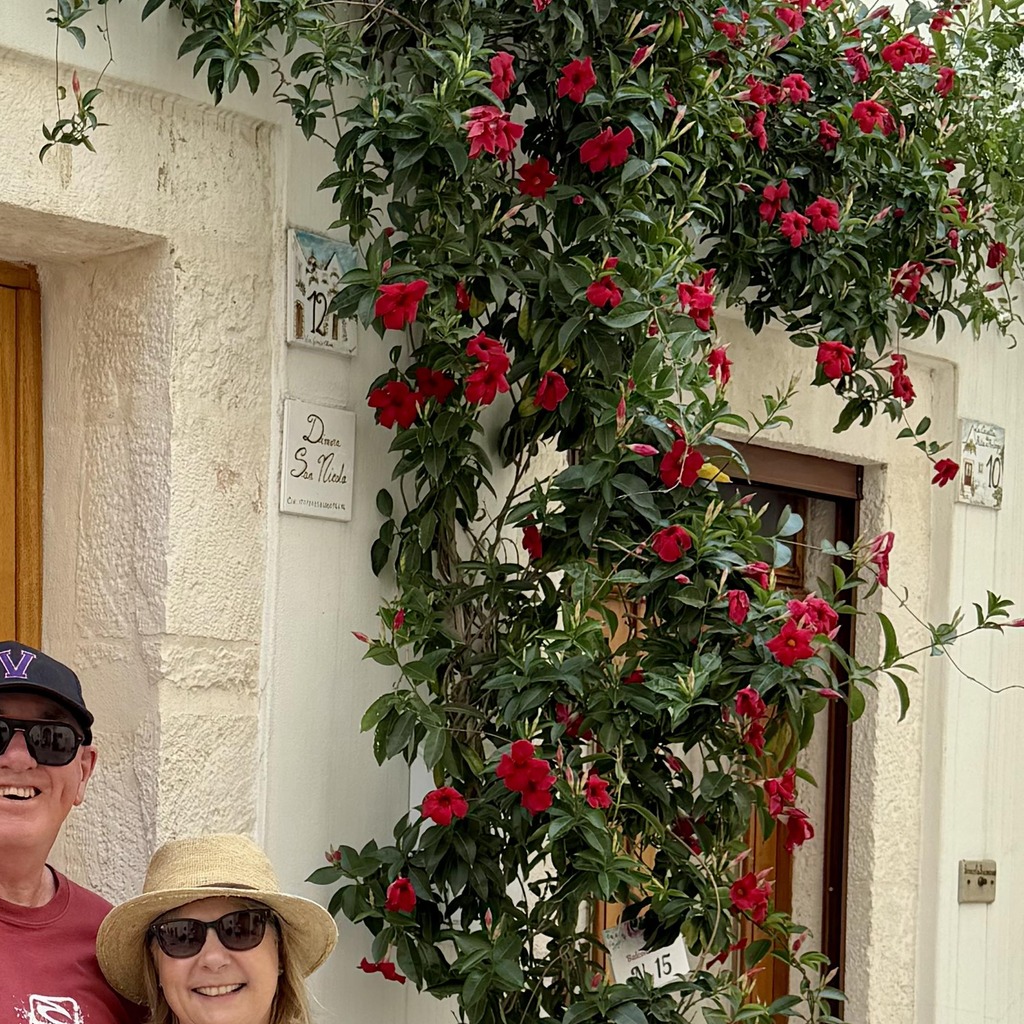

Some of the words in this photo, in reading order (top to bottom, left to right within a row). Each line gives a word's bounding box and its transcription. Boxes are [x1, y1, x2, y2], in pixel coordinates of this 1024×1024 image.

[307, 290, 327, 336] 12
[290, 447, 314, 481] San
[986, 454, 1002, 489] 10
[654, 952, 672, 979] 15
